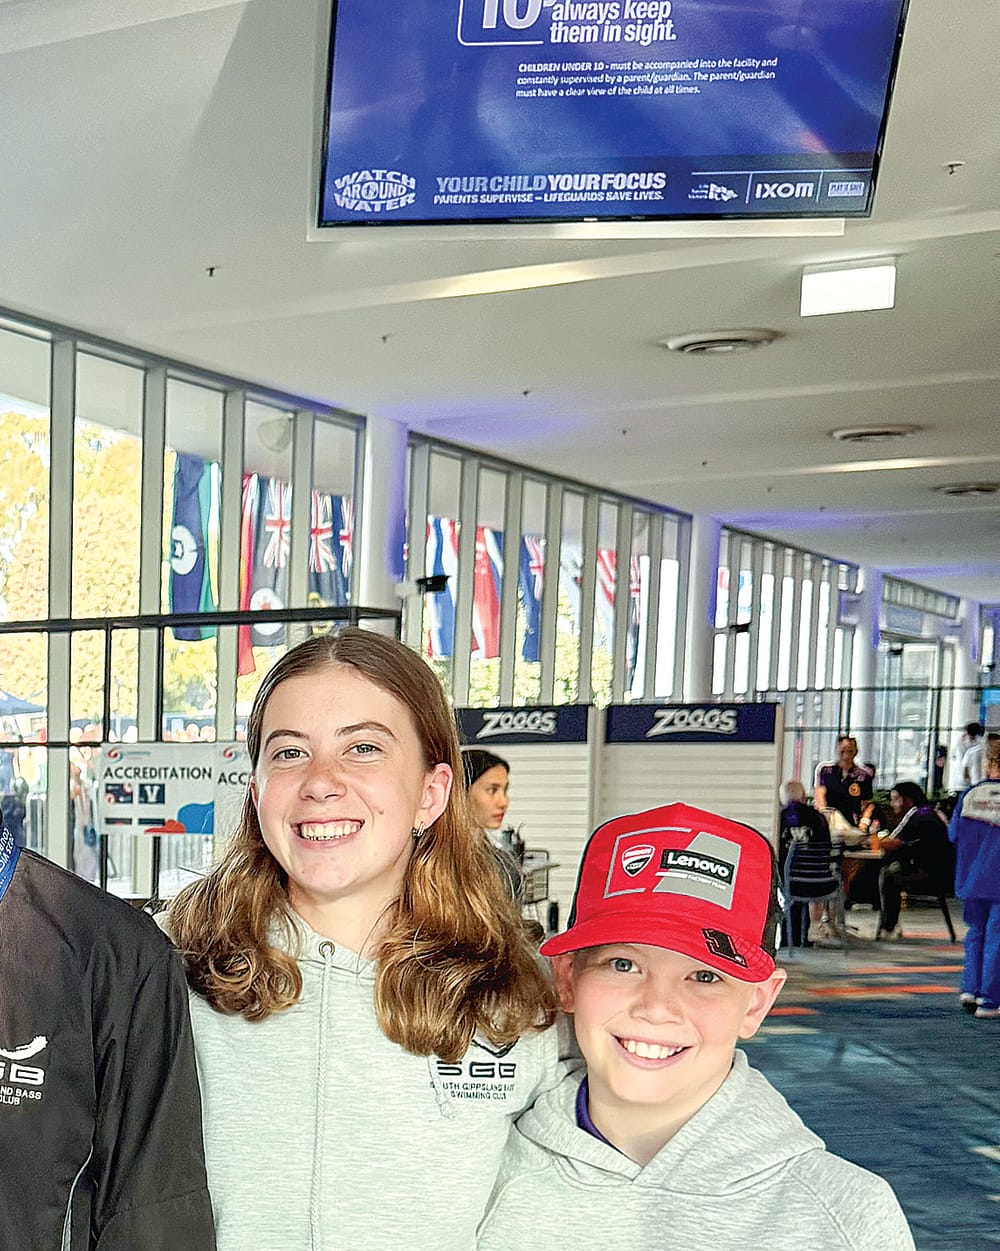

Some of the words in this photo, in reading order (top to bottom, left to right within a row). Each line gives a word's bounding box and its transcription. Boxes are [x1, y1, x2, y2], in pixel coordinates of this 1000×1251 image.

[551, 0, 620, 24] always
[623, 0, 672, 24] keep
[550, 21, 600, 44] them
[602, 20, 621, 43] in
[624, 19, 677, 47] sight.
[518, 62, 561, 73] CHILDREN
[562, 61, 592, 72] UNDER
[593, 61, 605, 71] 10
[610, 61, 632, 71] must
[700, 58, 717, 68] into
[717, 58, 732, 68] the
[761, 57, 778, 67] and
[605, 73, 616, 84] by
[693, 71, 708, 81] The
[515, 88, 537, 97] must
[537, 87, 557, 97] have
[607, 86, 617, 95] of
[617, 85, 632, 95] the
[334, 169, 416, 190] WATCH
[342, 180, 407, 200] AROUND
[433, 193, 480, 205] PARENTS
[480, 192, 534, 204] SUPERVISE
[543, 191, 605, 202] LIFEGUARDS
[606, 190, 633, 201] SAVE
[334, 192, 416, 212] WATER
[647, 708, 739, 738] ZOGGS
[103, 766, 213, 780] ACCREDITATION
[667, 852, 730, 878] Lenovo
[15, 1088, 43, 1100] BASS
[450, 1091, 491, 1100] SWIMMING
